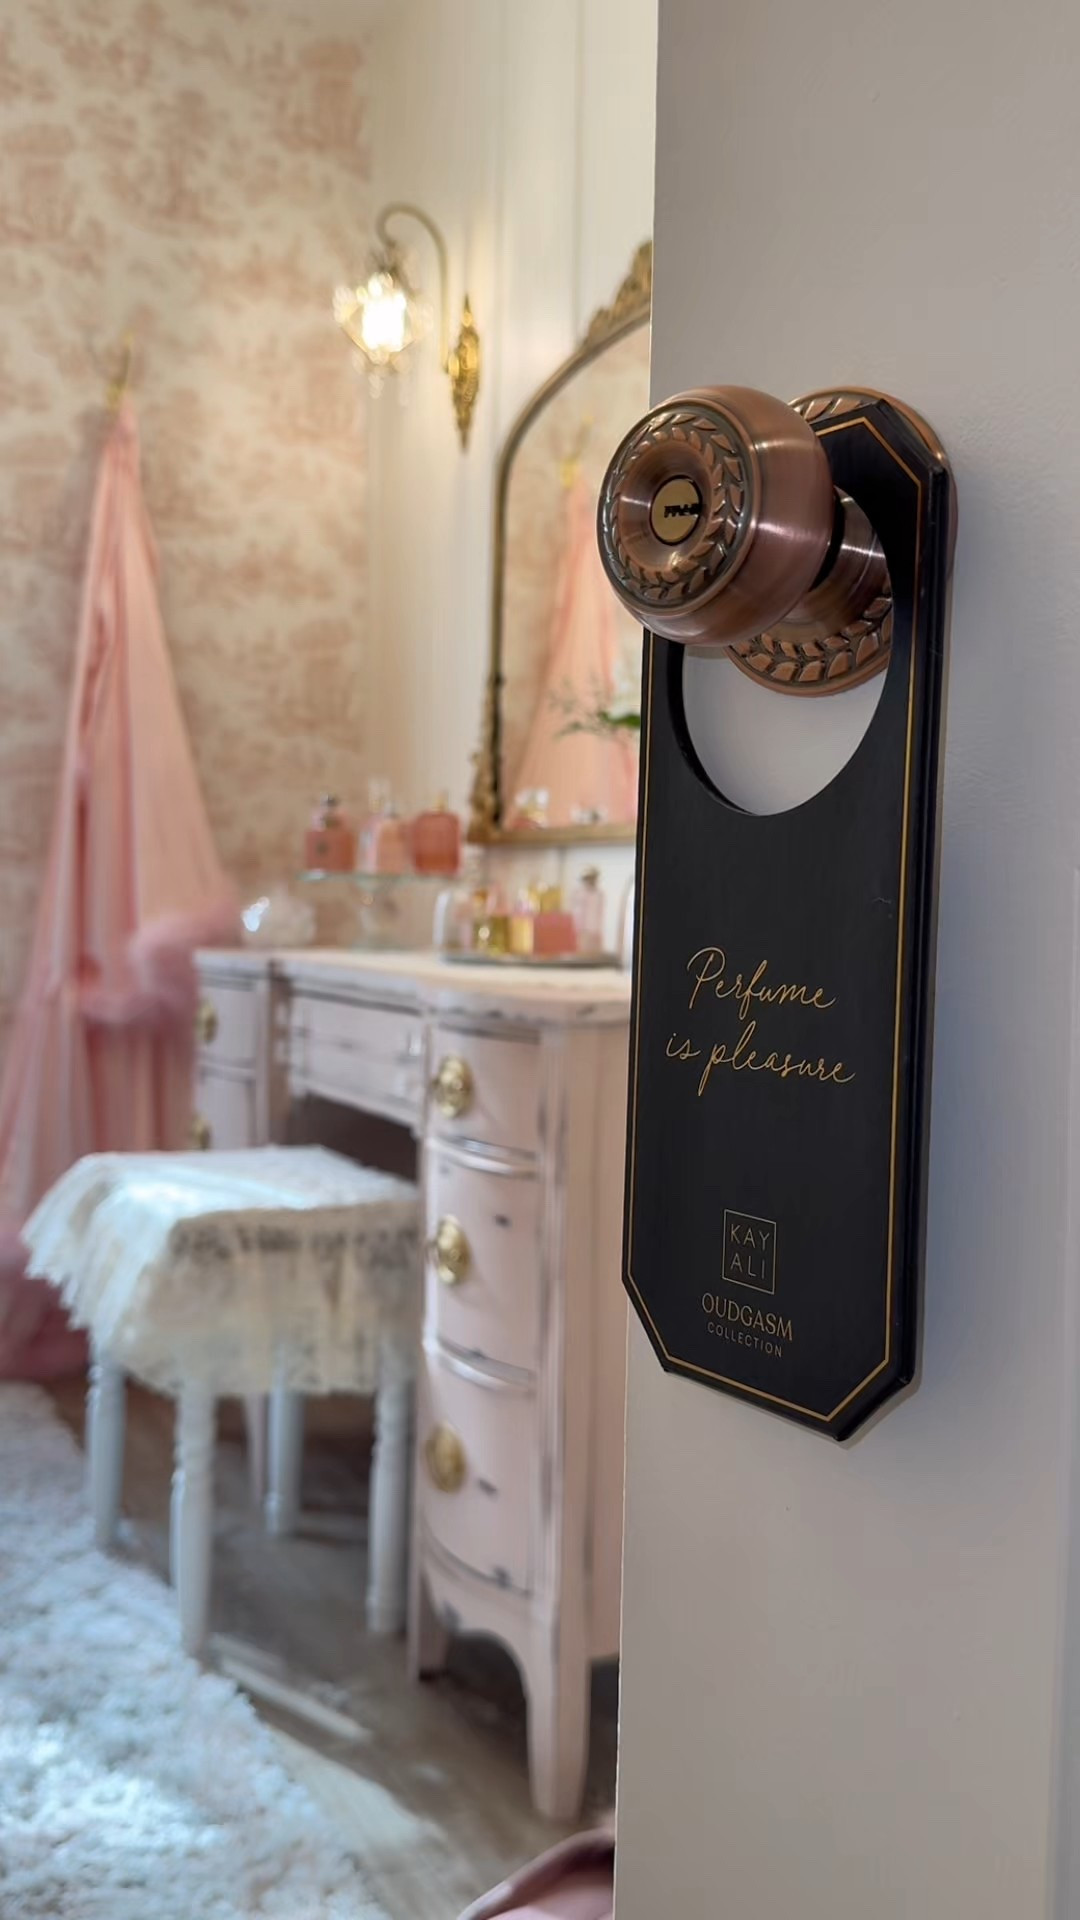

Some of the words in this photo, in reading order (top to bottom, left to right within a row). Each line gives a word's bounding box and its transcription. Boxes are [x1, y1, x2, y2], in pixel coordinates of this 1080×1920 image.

[686, 946, 836, 1021] Perfume
[665, 1032, 702, 1060] is
[698, 1020, 856, 1097] pleasure
[730, 1223, 771, 1251] KAY
[730, 1252, 766, 1280] ALI
[701, 1292, 793, 1341] OUDGASM
[707, 1321, 783, 1358] COLLECTION
